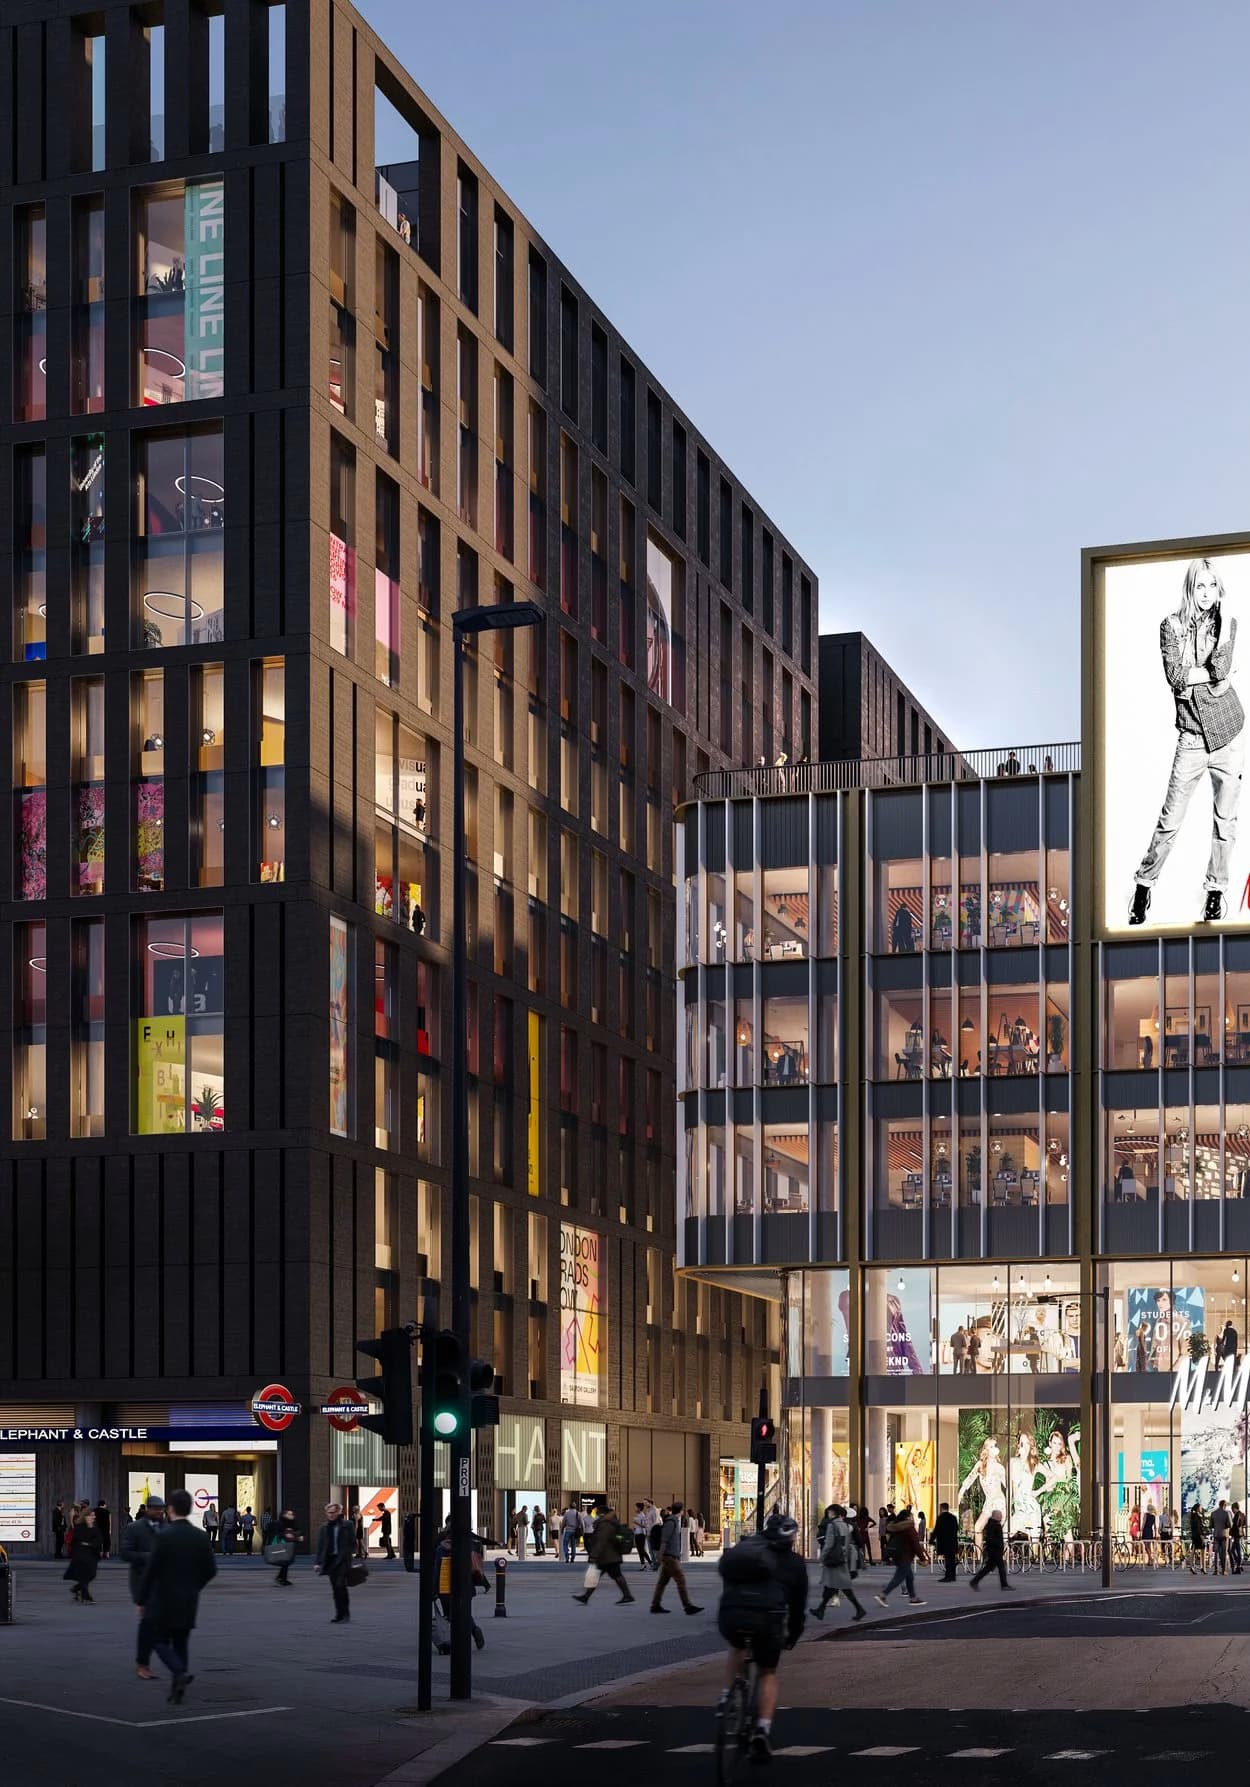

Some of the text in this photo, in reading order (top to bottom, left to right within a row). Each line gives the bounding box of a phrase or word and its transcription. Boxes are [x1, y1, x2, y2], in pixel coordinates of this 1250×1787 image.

[200, 253, 224, 338] LINE
[1141, 1311, 1190, 1320] STUDENTS
[253, 1403, 276, 1411] ELEPHANT
[0, 1428, 148, 1440] LEPHANT & CASTLE
